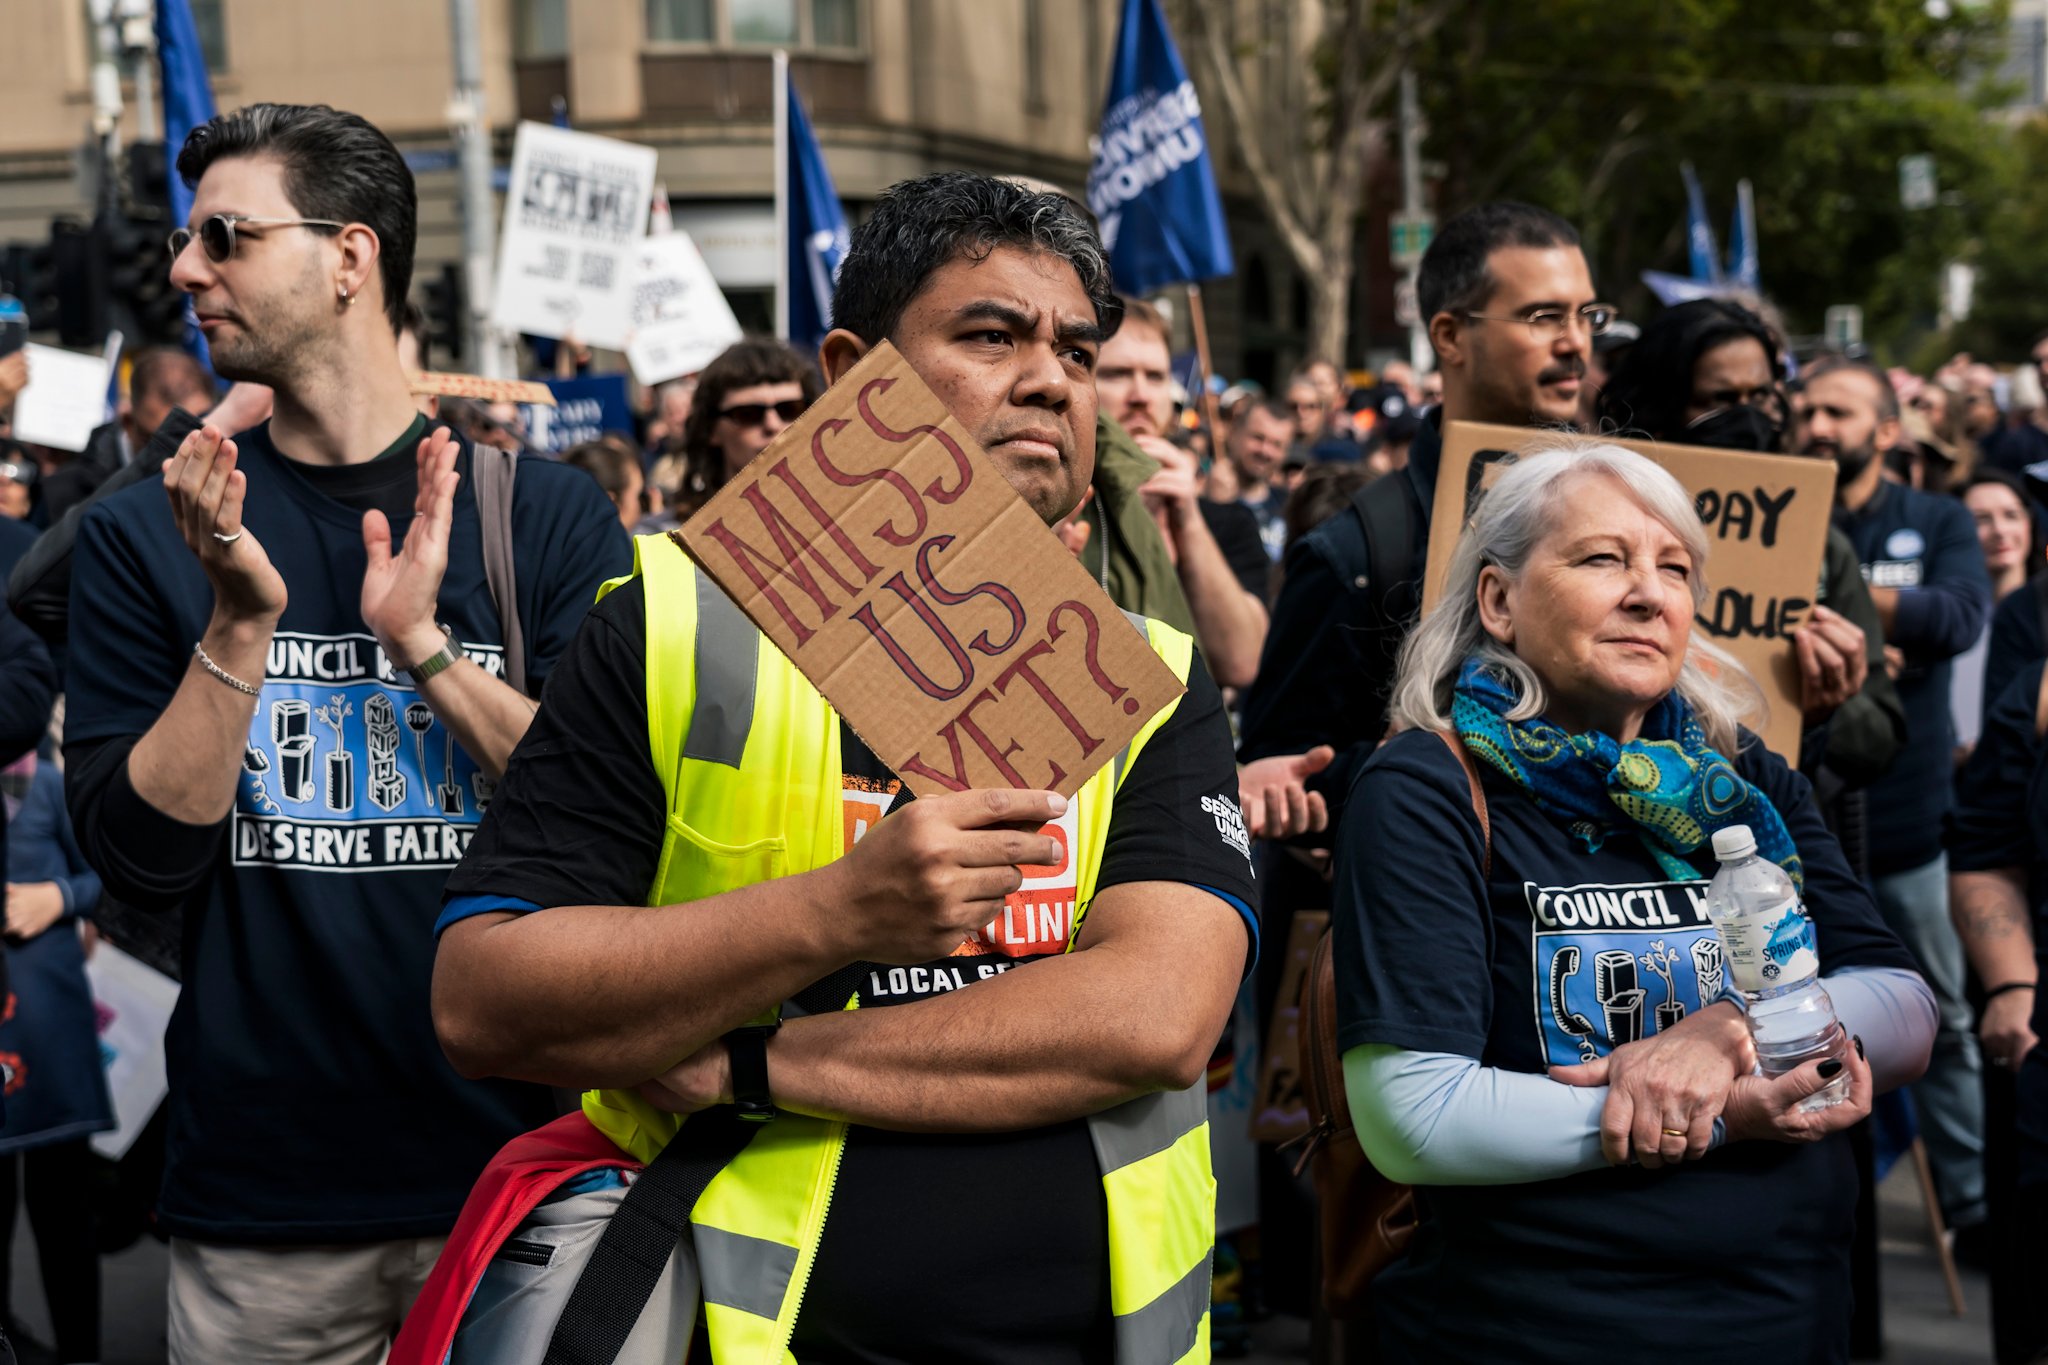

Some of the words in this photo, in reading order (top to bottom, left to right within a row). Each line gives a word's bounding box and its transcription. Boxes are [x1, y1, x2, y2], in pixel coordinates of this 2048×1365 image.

[703, 377, 974, 648] MISS
[849, 534, 1027, 702] US
[1694, 586, 1810, 641] DUE
[267, 640, 366, 680] UNCIL
[407, 710, 433, 724] STOP
[900, 600, 1141, 793] YET?
[240, 823, 372, 865] DESERVE
[1536, 887, 1681, 927] COUNCIL
[1762, 936, 1801, 962] SPRING
[870, 966, 970, 996] LOCAL
